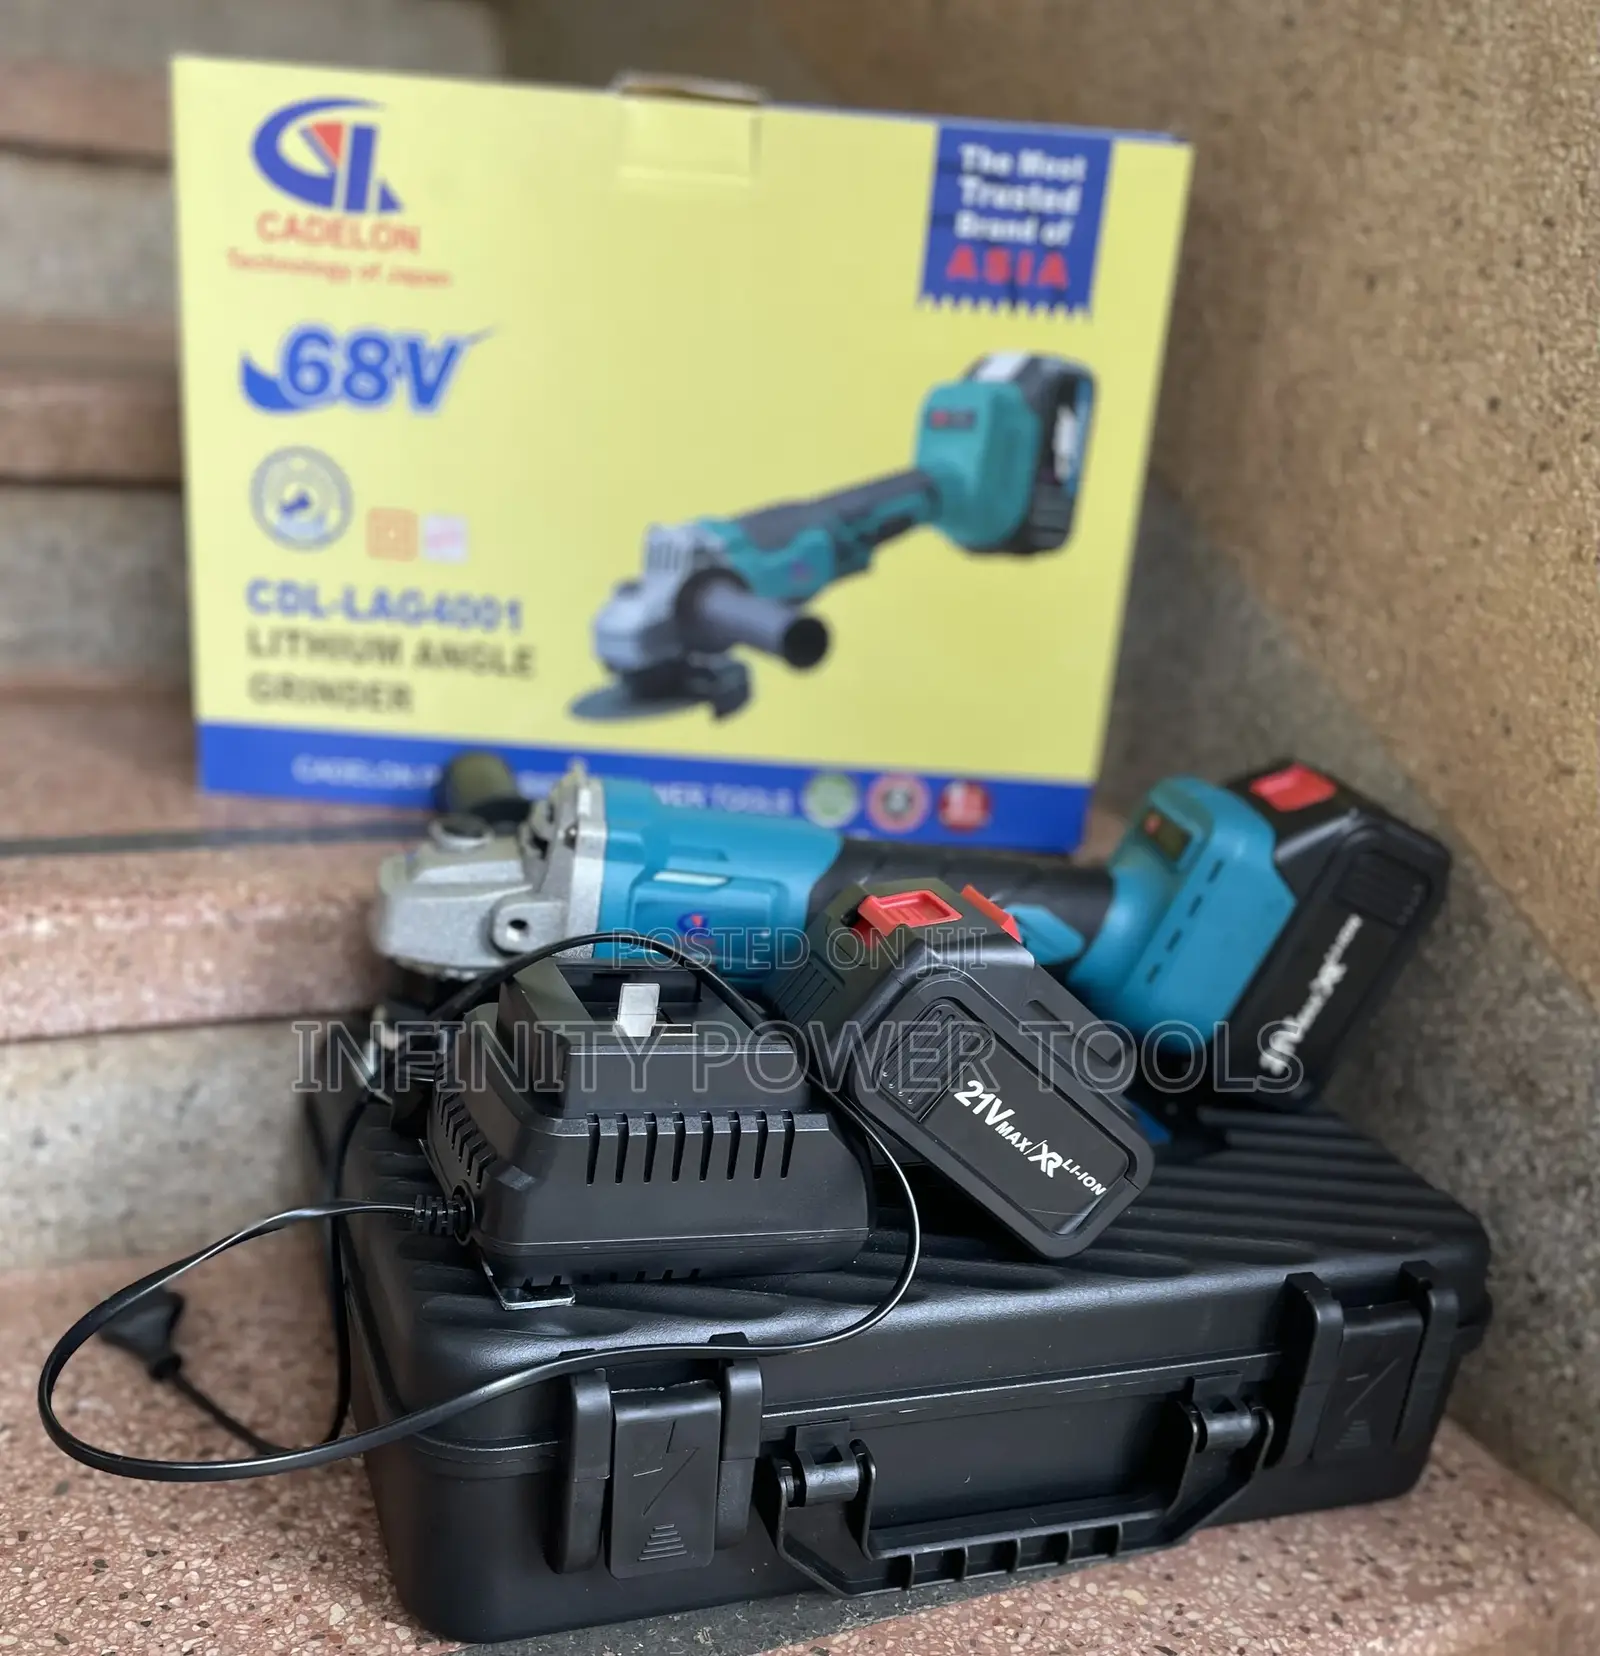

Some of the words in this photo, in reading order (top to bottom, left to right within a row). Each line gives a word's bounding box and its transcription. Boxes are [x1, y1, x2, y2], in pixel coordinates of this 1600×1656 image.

[958, 143, 1015, 178] The
[1017, 147, 1088, 183] Most
[957, 173, 1083, 216] Trusted
[945, 244, 1070, 290] ASIA
[281, 322, 464, 416] 68V
[247, 624, 405, 668] LITHIUM
[411, 637, 537, 680] ANGLE
[248, 671, 414, 714] GRINDER
